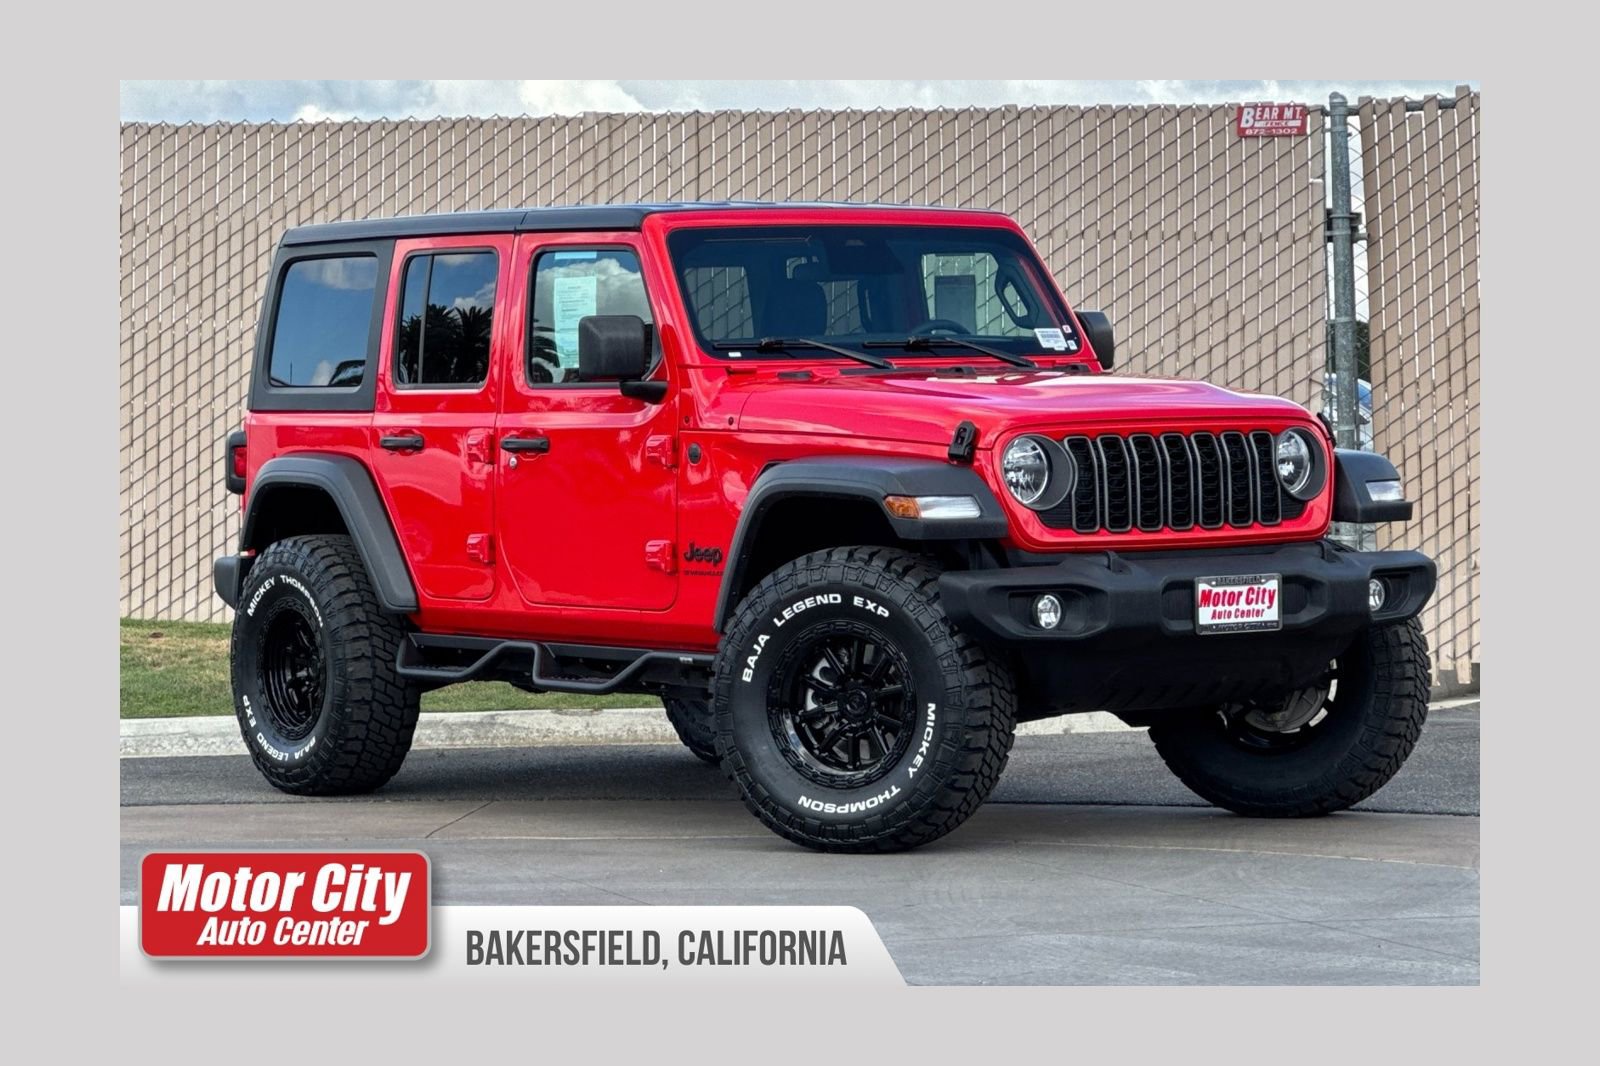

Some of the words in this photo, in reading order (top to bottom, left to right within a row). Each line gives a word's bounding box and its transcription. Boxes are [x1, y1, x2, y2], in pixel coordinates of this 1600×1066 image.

[1240, 107, 1280, 128] BEAR
[684, 541, 722, 566] Jeep
[247, 577, 275, 617] MICKEY
[280, 575, 324, 628] THOMPSON
[1199, 589, 1243, 608] Motor
[1245, 586, 1276, 609] City
[1211, 608, 1232, 620] Auto
[1234, 607, 1265, 619] Center
[742, 633, 770, 682] BAJA
[774, 594, 842, 627] LEGEND
[854, 596, 890, 618] EXP
[242, 694, 257, 728] EXP
[256, 732, 290, 762] LEGEND
[908, 703, 936, 779] MICKEY
[798, 784, 901, 814] THOMPSON
